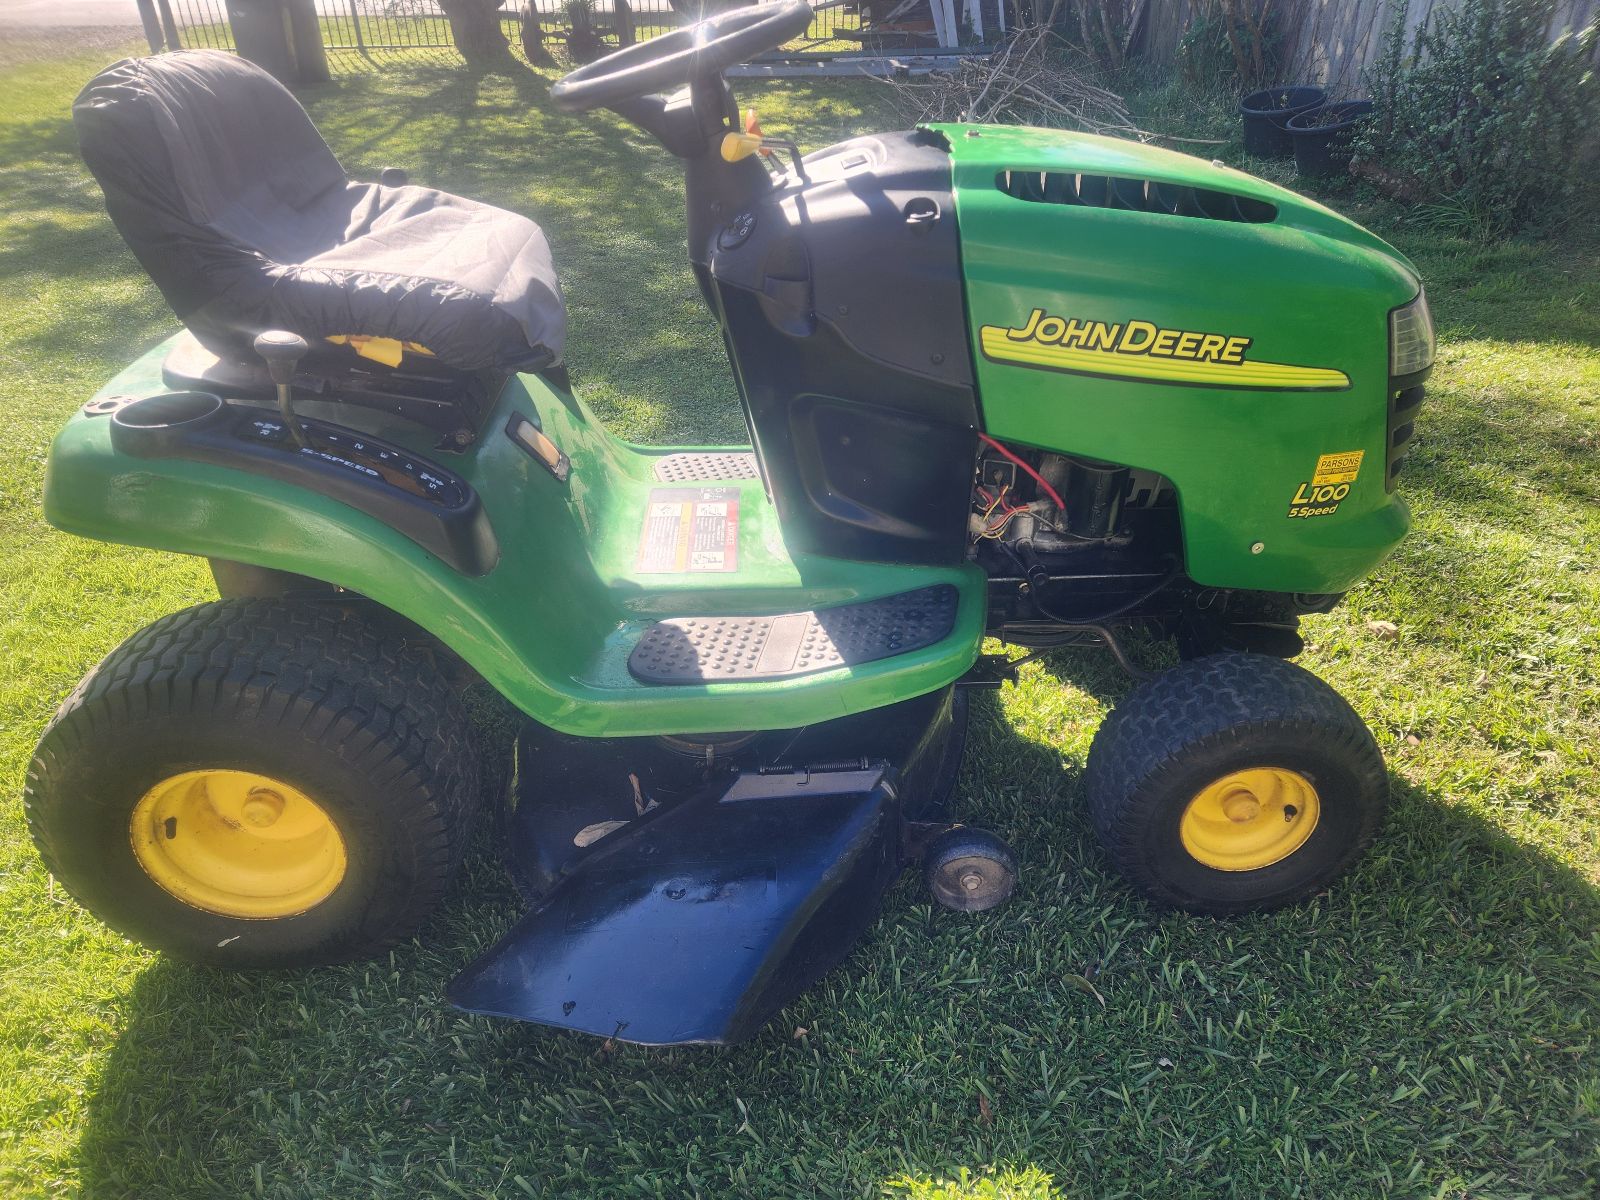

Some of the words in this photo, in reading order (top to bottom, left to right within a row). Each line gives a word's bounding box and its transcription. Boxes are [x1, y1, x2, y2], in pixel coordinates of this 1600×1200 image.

[1007, 308, 1121, 351] JOHN
[1116, 319, 1254, 366] DEERE
[354, 442, 364, 450] 2
[380, 451, 389, 459] 3
[1321, 457, 1360, 469] PARSONS
[429, 482, 437, 490] 5
[1291, 482, 1350, 505] L100
